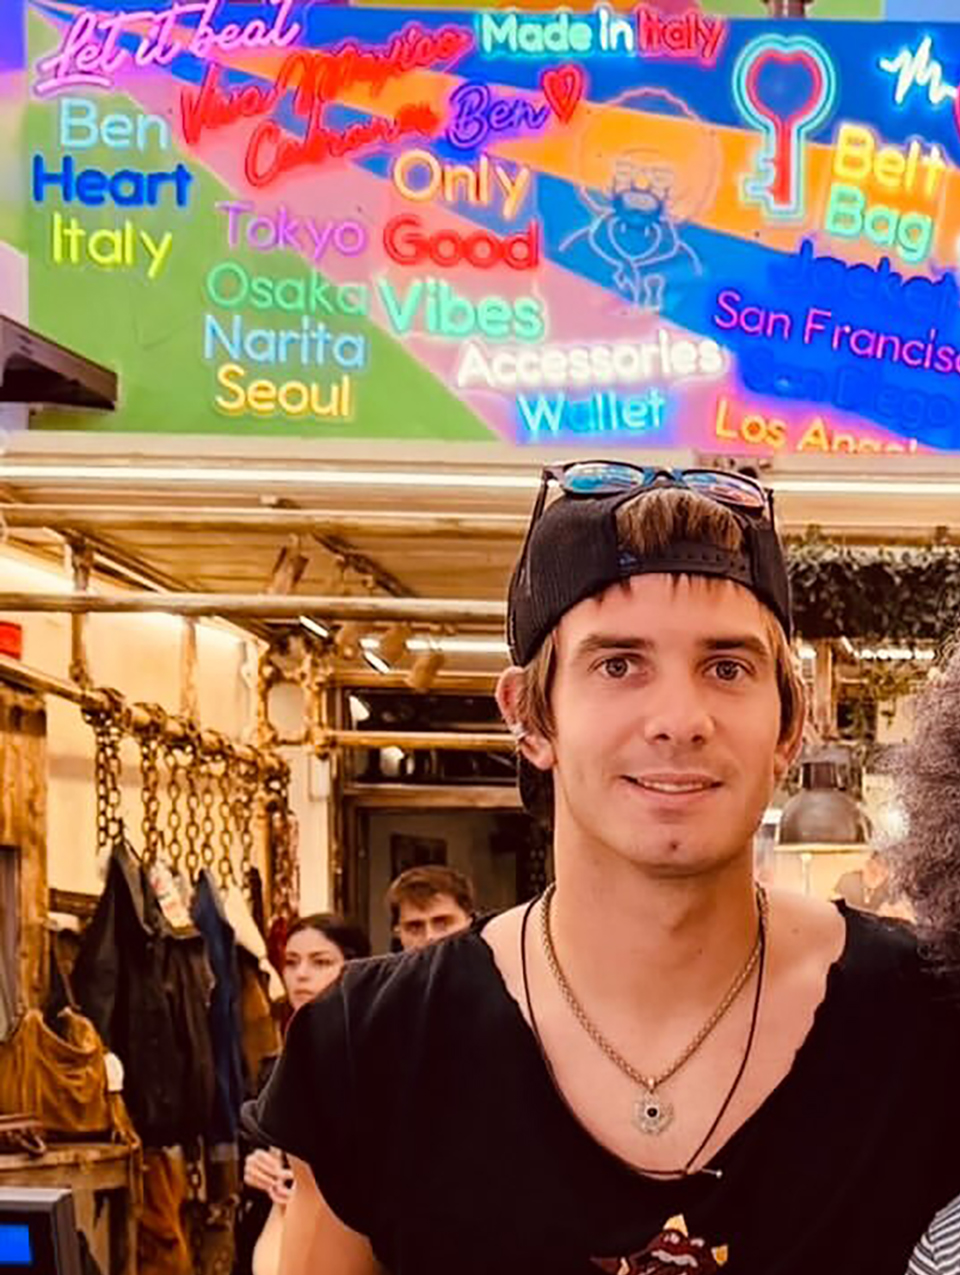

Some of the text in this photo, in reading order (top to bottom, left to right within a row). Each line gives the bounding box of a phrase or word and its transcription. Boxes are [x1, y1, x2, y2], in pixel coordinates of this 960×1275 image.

[481, 14, 593, 52] Made
[638, 12, 726, 66] Italy
[59, 98, 170, 149] Ben
[447, 84, 548, 147] Ben
[33, 154, 193, 207] Heart
[393, 150, 530, 218] Only
[834, 124, 944, 195] Belt
[51, 212, 173, 278] Italy
[215, 204, 366, 262] Tokyo
[383, 218, 540, 268] Good
[824, 183, 935, 260] Bag
[206, 263, 366, 315] Osaka
[377, 279, 543, 340] Vibes
[204, 315, 365, 368] Narita
[714, 291, 792, 345] San
[457, 331, 724, 388] Accessories
[216, 364, 352, 417] Seoul
[517, 391, 664, 437] Wallet
[715, 397, 785, 448] Los
